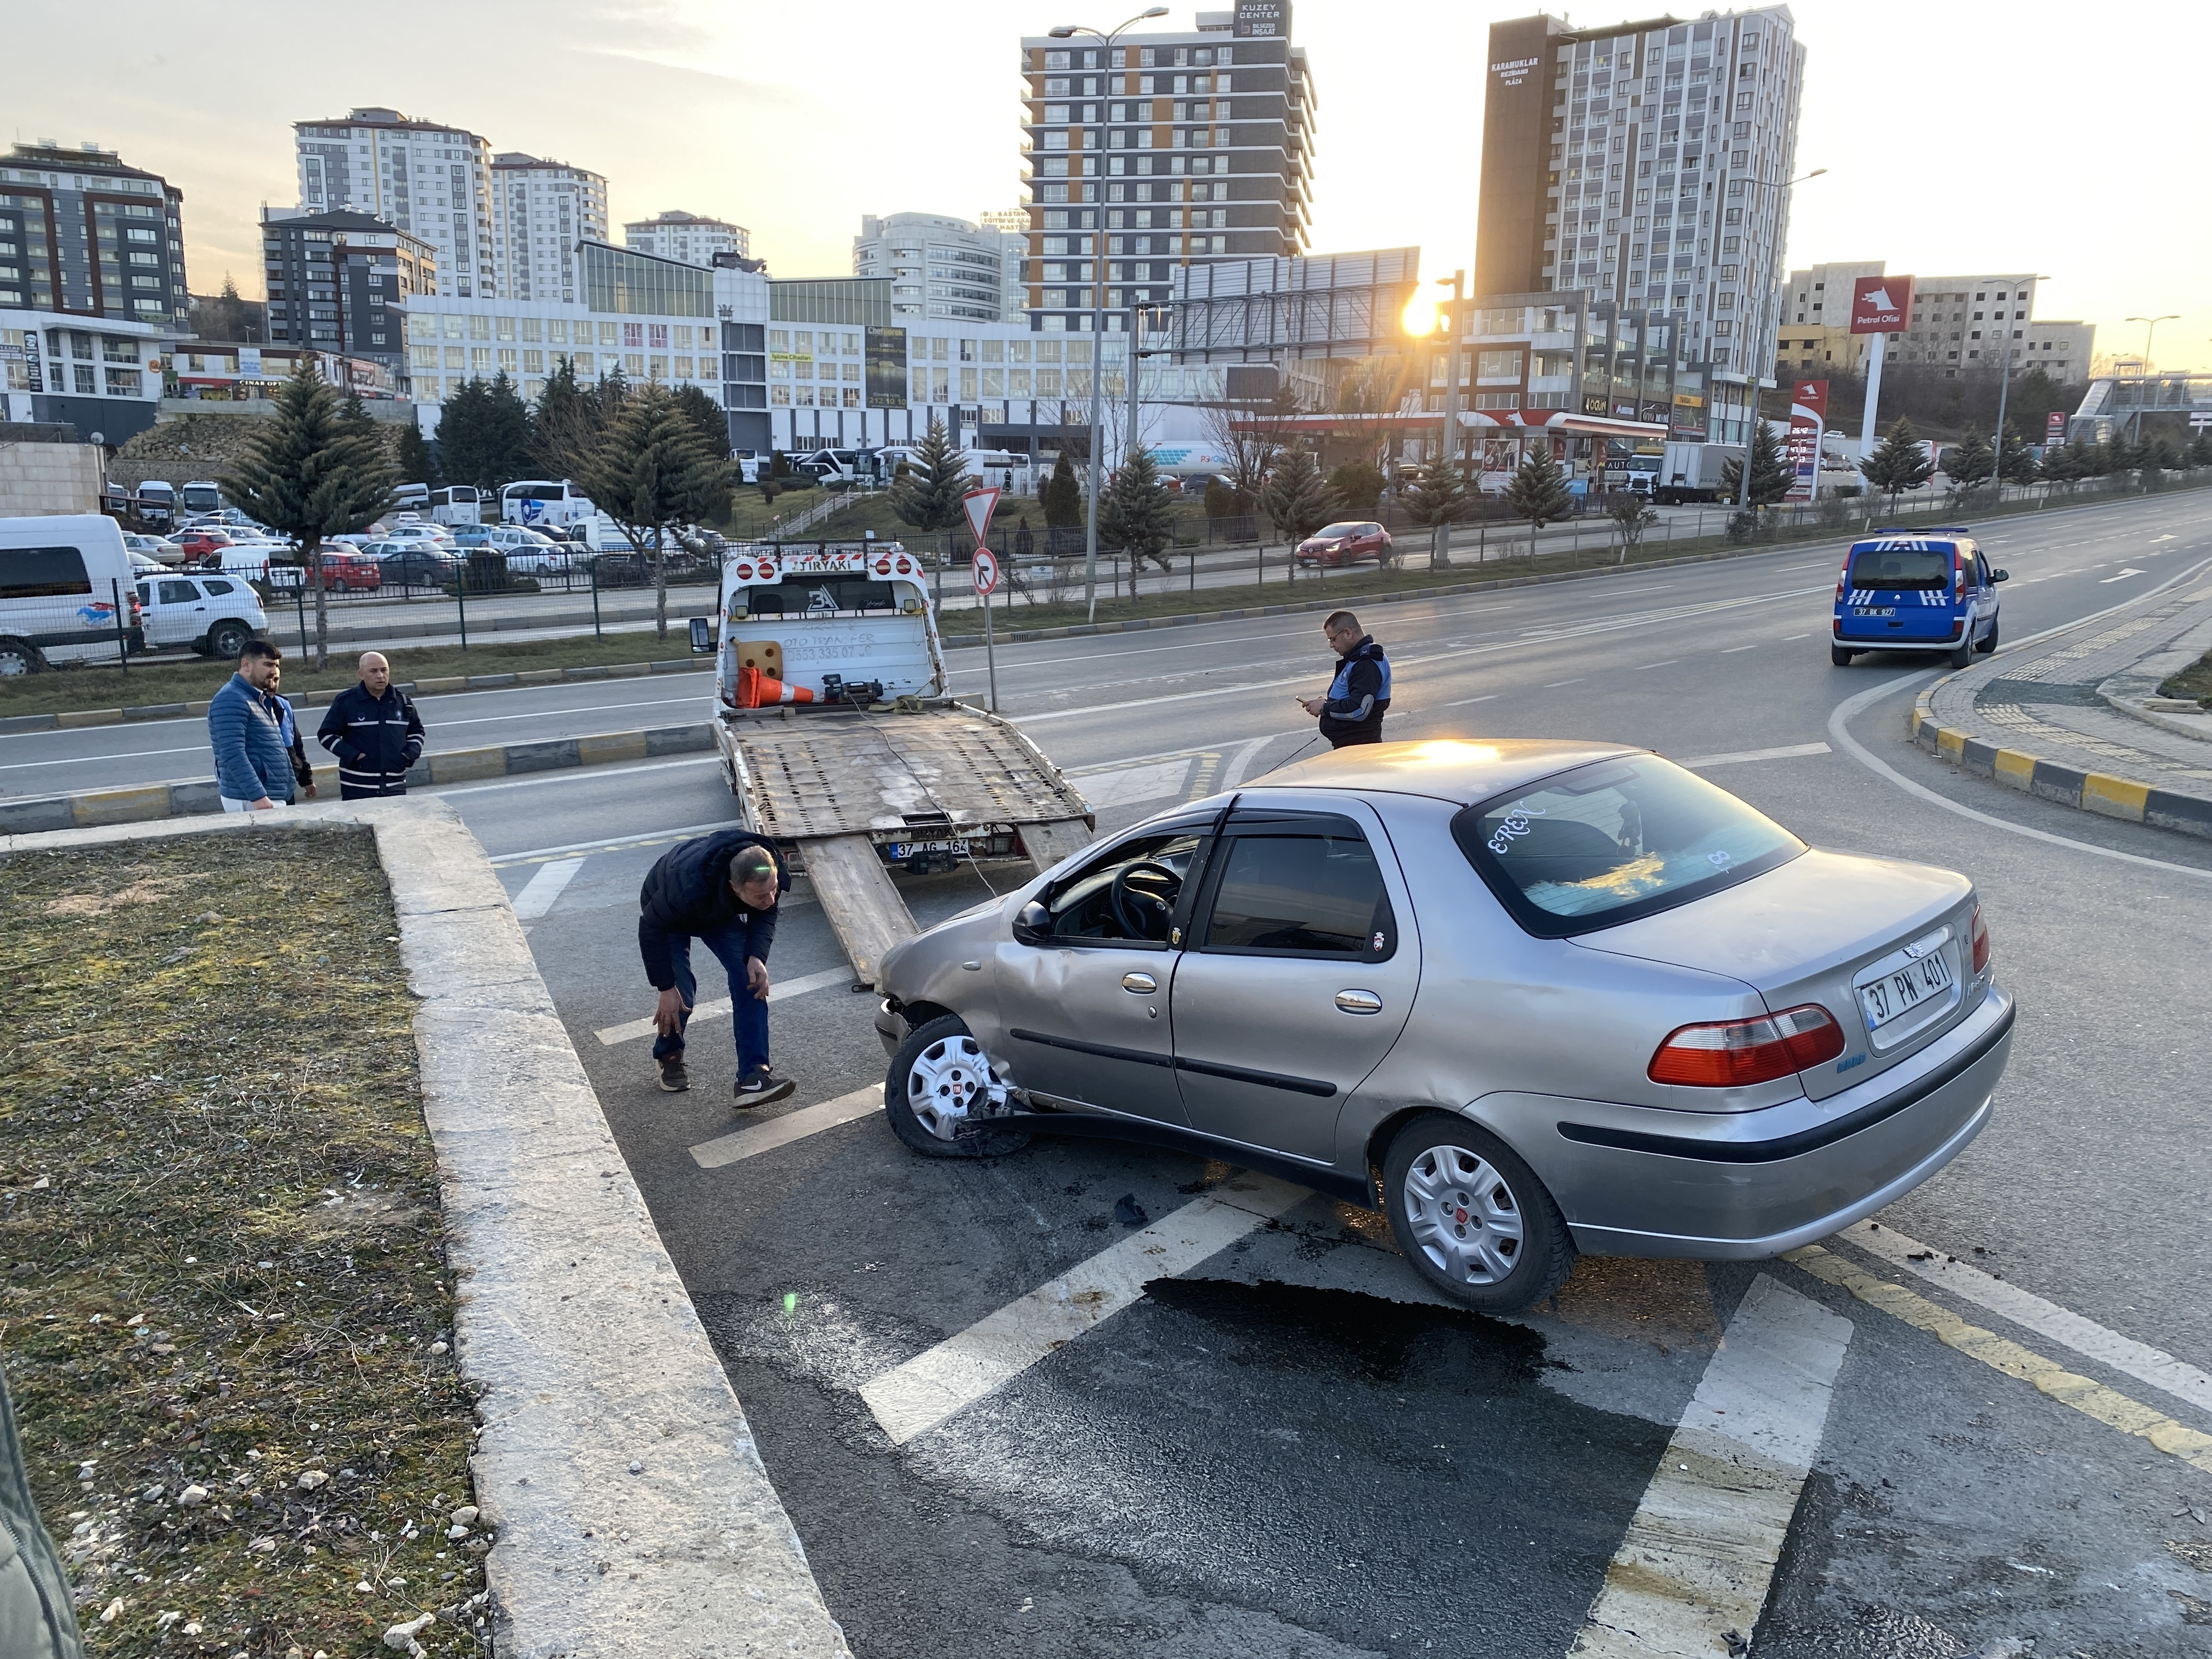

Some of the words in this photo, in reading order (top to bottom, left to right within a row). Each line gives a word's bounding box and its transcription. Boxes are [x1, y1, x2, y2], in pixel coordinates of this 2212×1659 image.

[1492, 57, 1538, 72] KARAMUKLAR
[1857, 316, 1881, 324] Petrol
[1881, 314, 1900, 323] Ofisi
[783, 637, 808, 648] OTO
[818, 646, 838, 659] 335
[842, 646, 855, 658] 07
[898, 843, 913, 856] 37
[922, 842, 937, 851] AG
[946, 840, 967, 853] 164
[1869, 983, 1891, 1019] 37
[1893, 970, 1919, 1006] PN
[1921, 953, 1948, 990] 401
